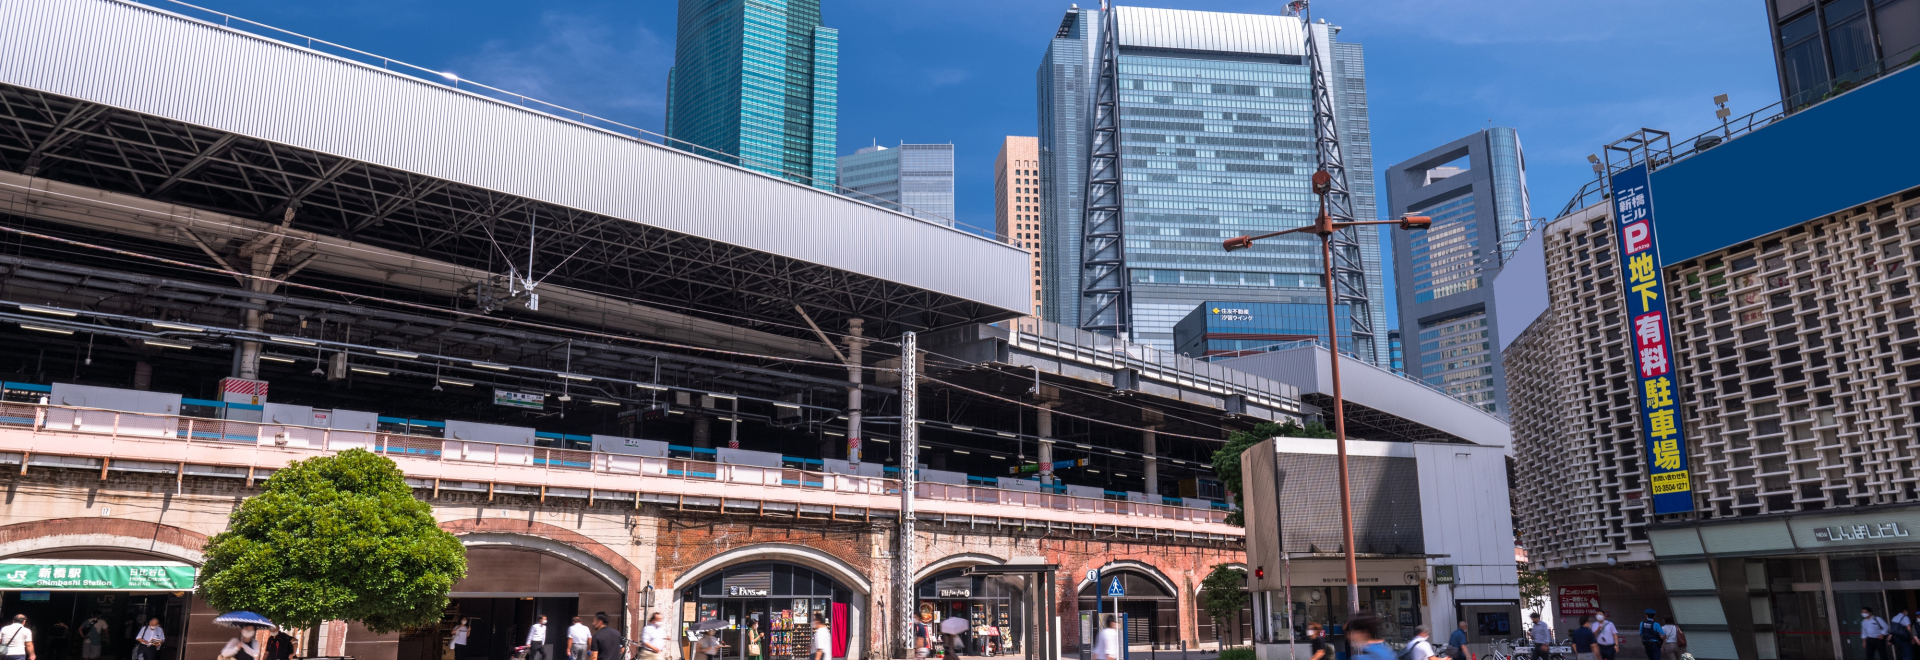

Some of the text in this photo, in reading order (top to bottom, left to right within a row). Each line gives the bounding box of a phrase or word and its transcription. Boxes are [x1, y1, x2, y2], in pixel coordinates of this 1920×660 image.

[1617, 185, 1644, 201] ニュー
[1618, 193, 1645, 213] 新橋
[1621, 207, 1647, 224] ビル
[6, 570, 27, 580] JR
[38, 567, 167, 579] 新橋駅 日比谷口
